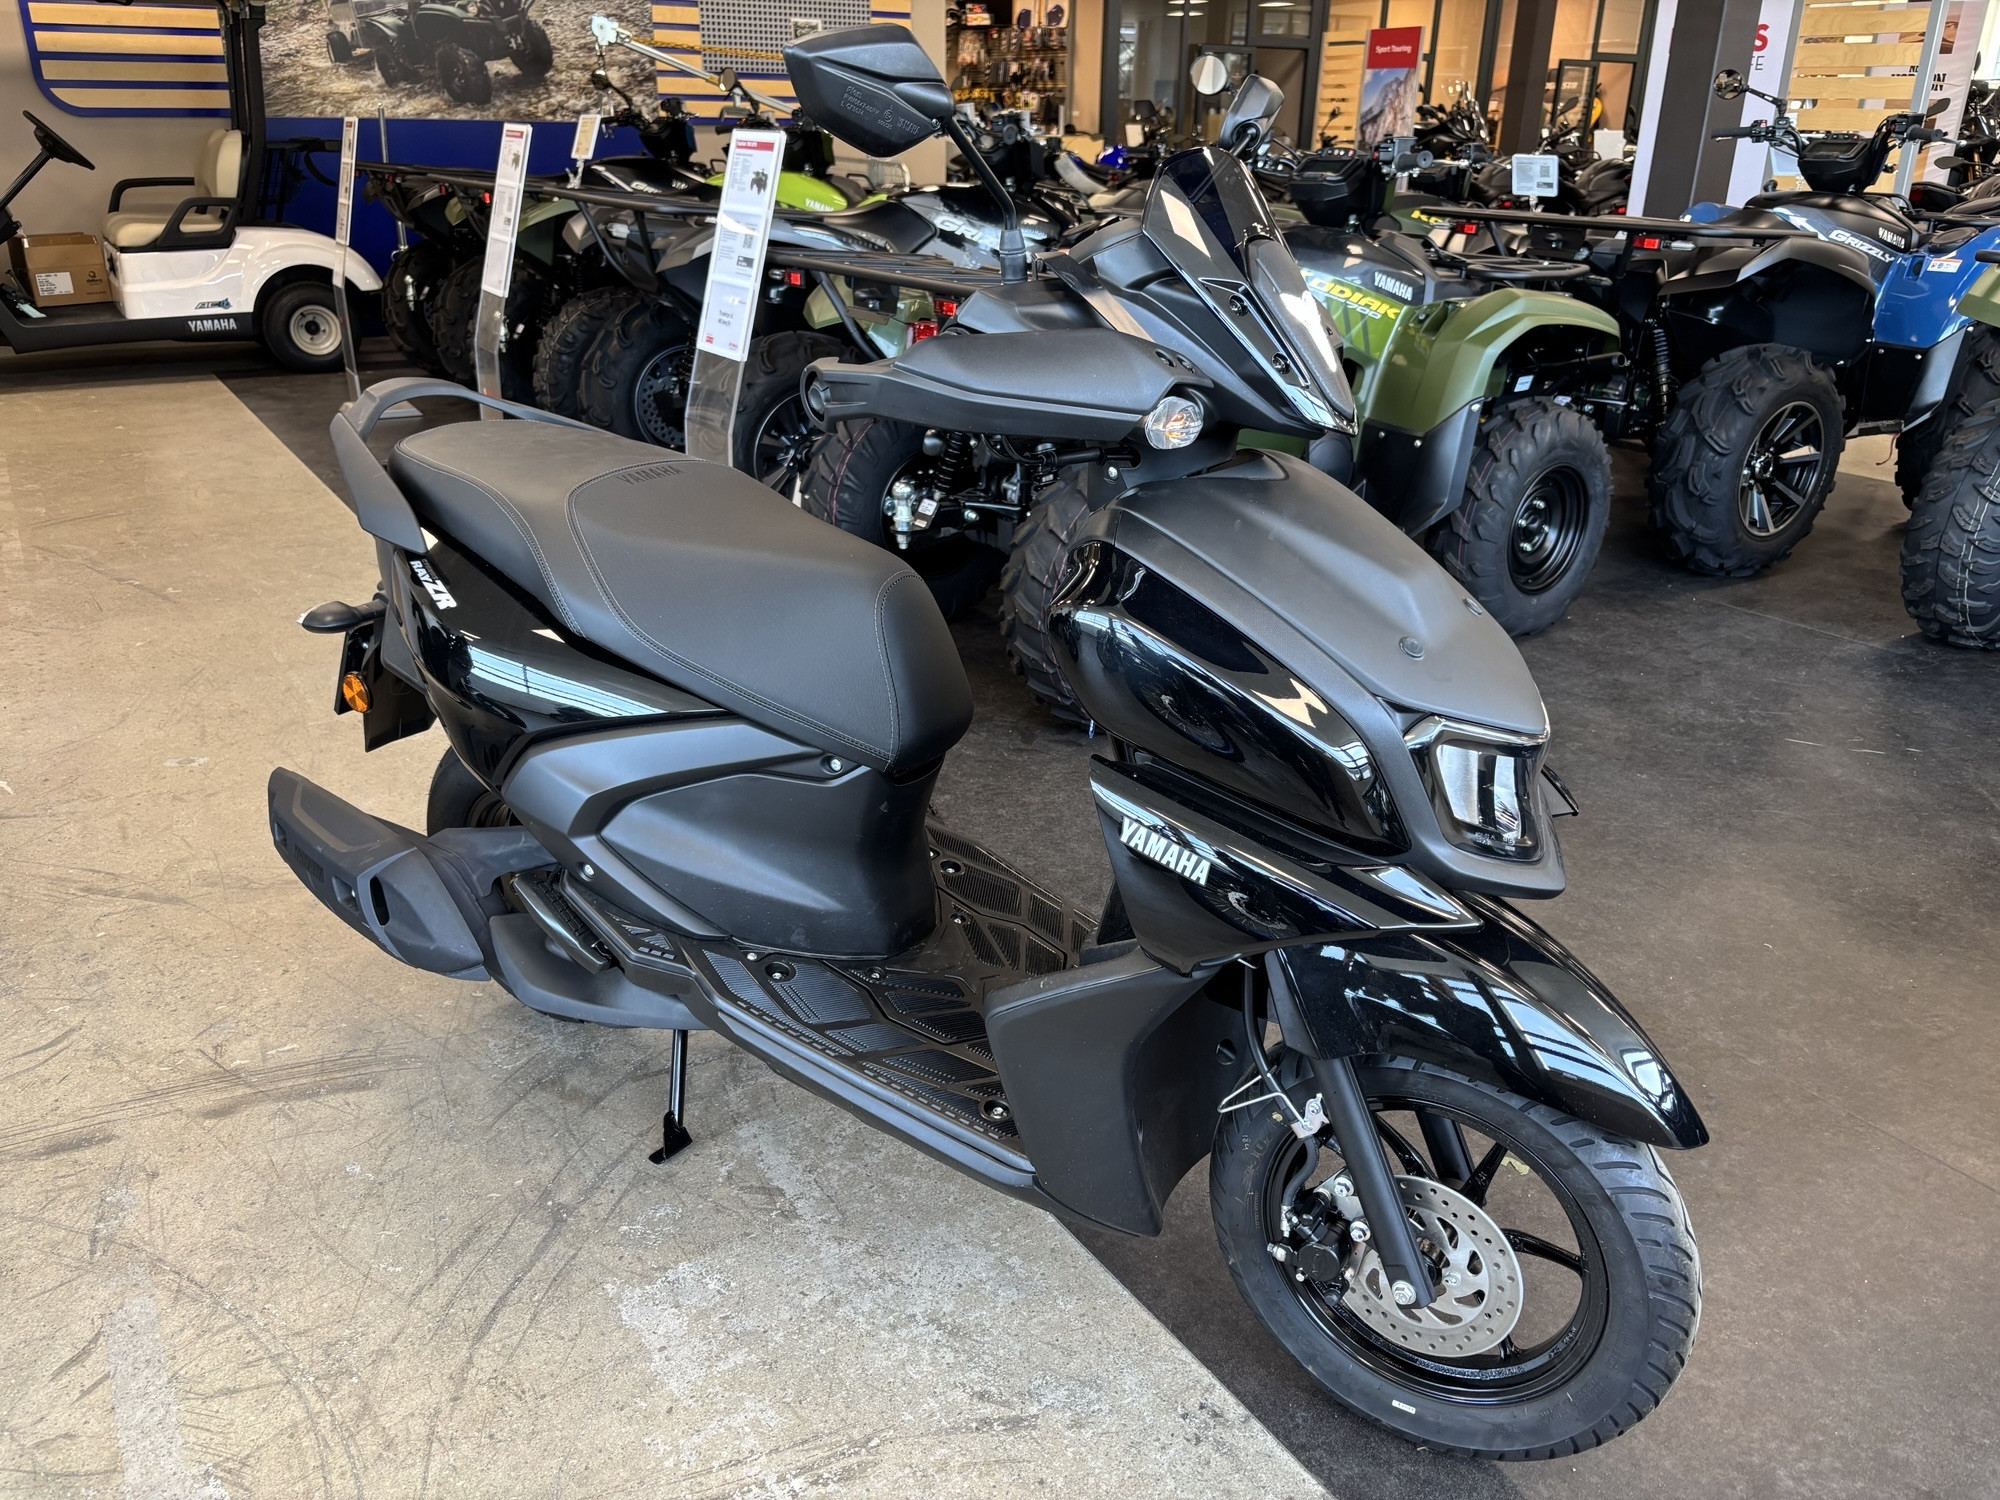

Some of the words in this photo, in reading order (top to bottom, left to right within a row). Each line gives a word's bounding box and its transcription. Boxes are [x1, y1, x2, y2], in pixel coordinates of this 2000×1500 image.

[1391, 45, 1412, 54] Touring
[1829, 229, 1895, 264] GRIZZLY
[1878, 226, 1905, 250] YAMAHA
[1374, 271, 1413, 301] YAMAHA
[188, 318, 238, 333] YAMAHA
[616, 465, 685, 485] YAMAHA
[1120, 815, 1212, 887] YAMAHA
